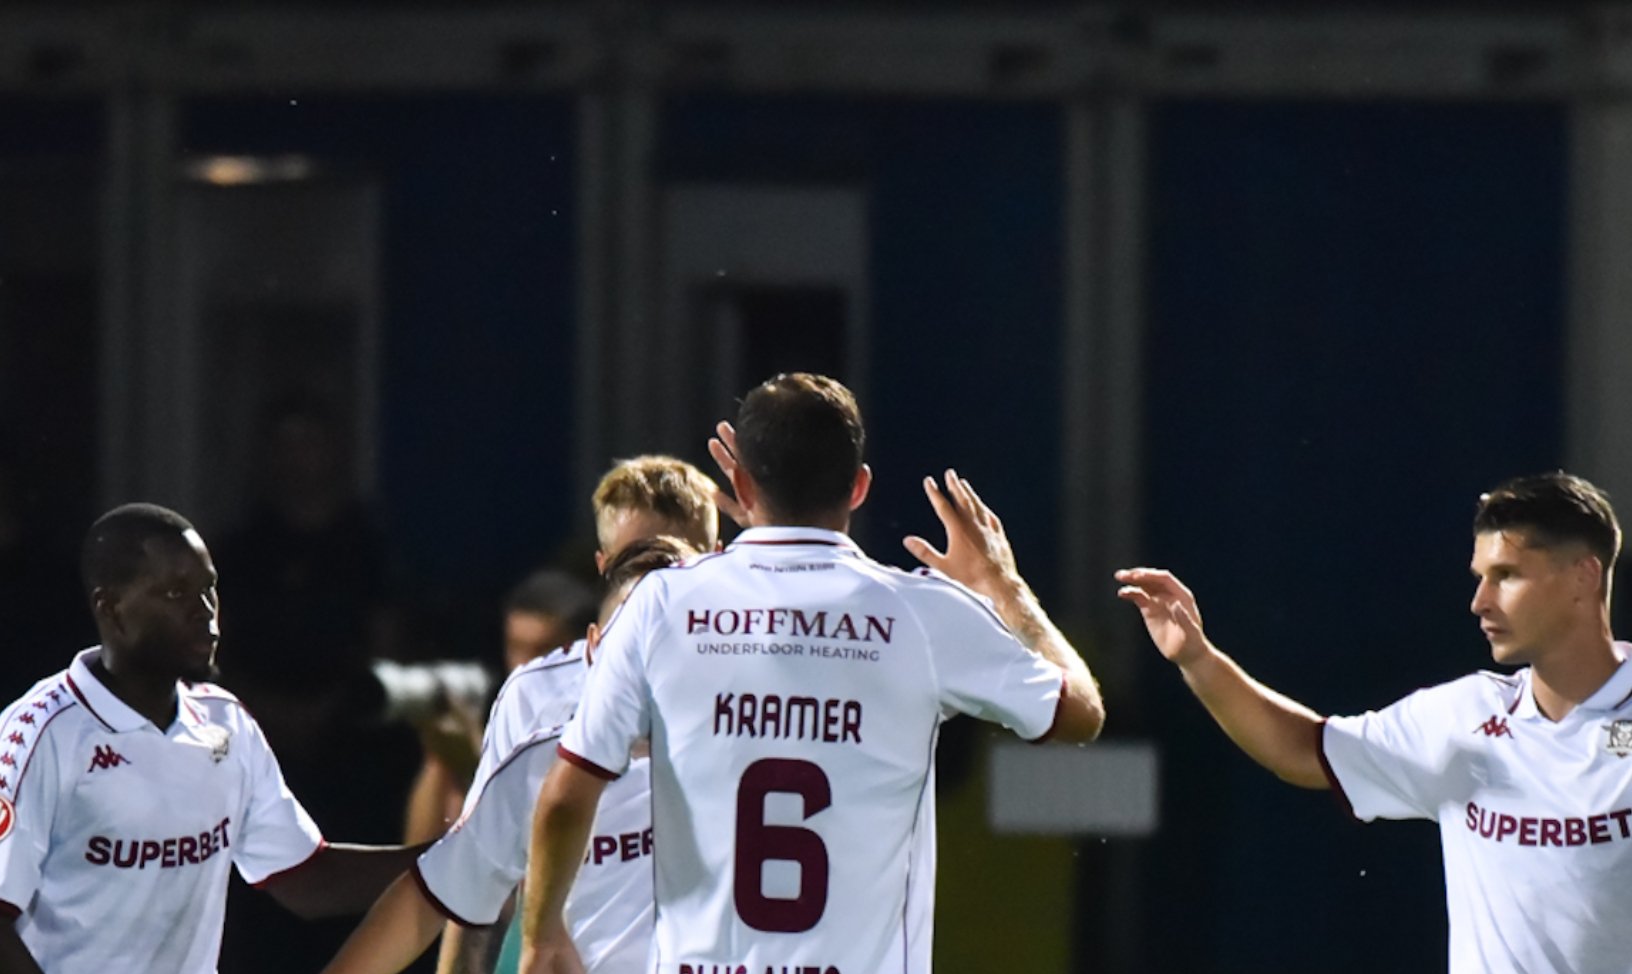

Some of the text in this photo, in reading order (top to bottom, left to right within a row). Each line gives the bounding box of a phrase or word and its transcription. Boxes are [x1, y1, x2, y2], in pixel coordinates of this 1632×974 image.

[687, 608, 896, 644] HOFFMAN
[697, 642, 880, 662] UNDERFLOOR HEATING
[713, 691, 863, 745] KRAMER
[85, 816, 231, 870] SUPERBET
[733, 757, 832, 933] 6
[1466, 801, 1632, 848] SUPERBET
